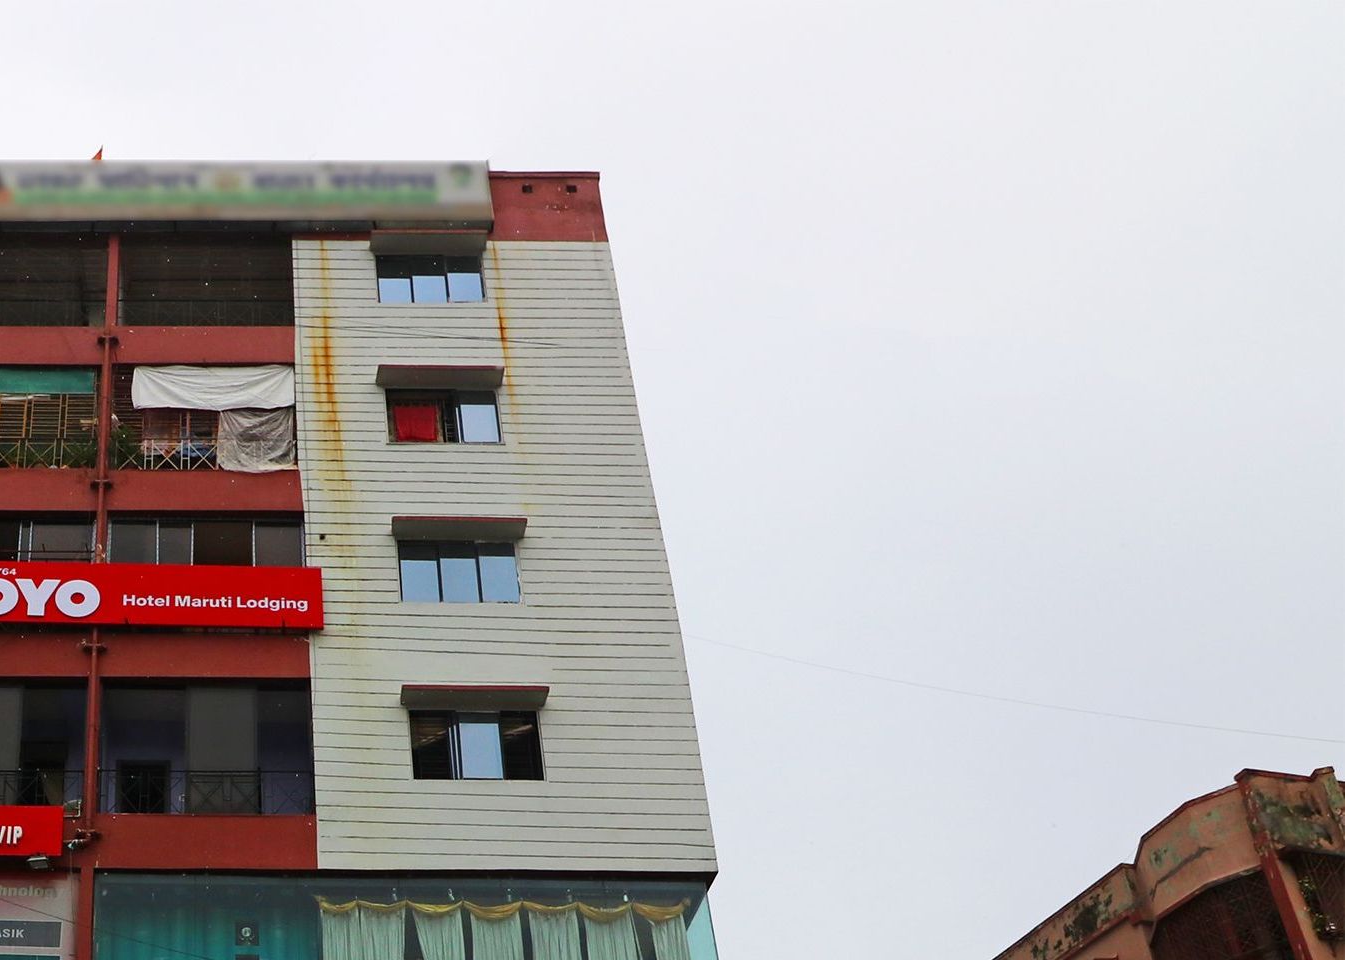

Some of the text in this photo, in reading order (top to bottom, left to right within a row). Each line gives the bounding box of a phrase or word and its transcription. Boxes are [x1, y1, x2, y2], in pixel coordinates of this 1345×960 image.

[122, 594, 308, 612] Hotel Maruti Lodging
